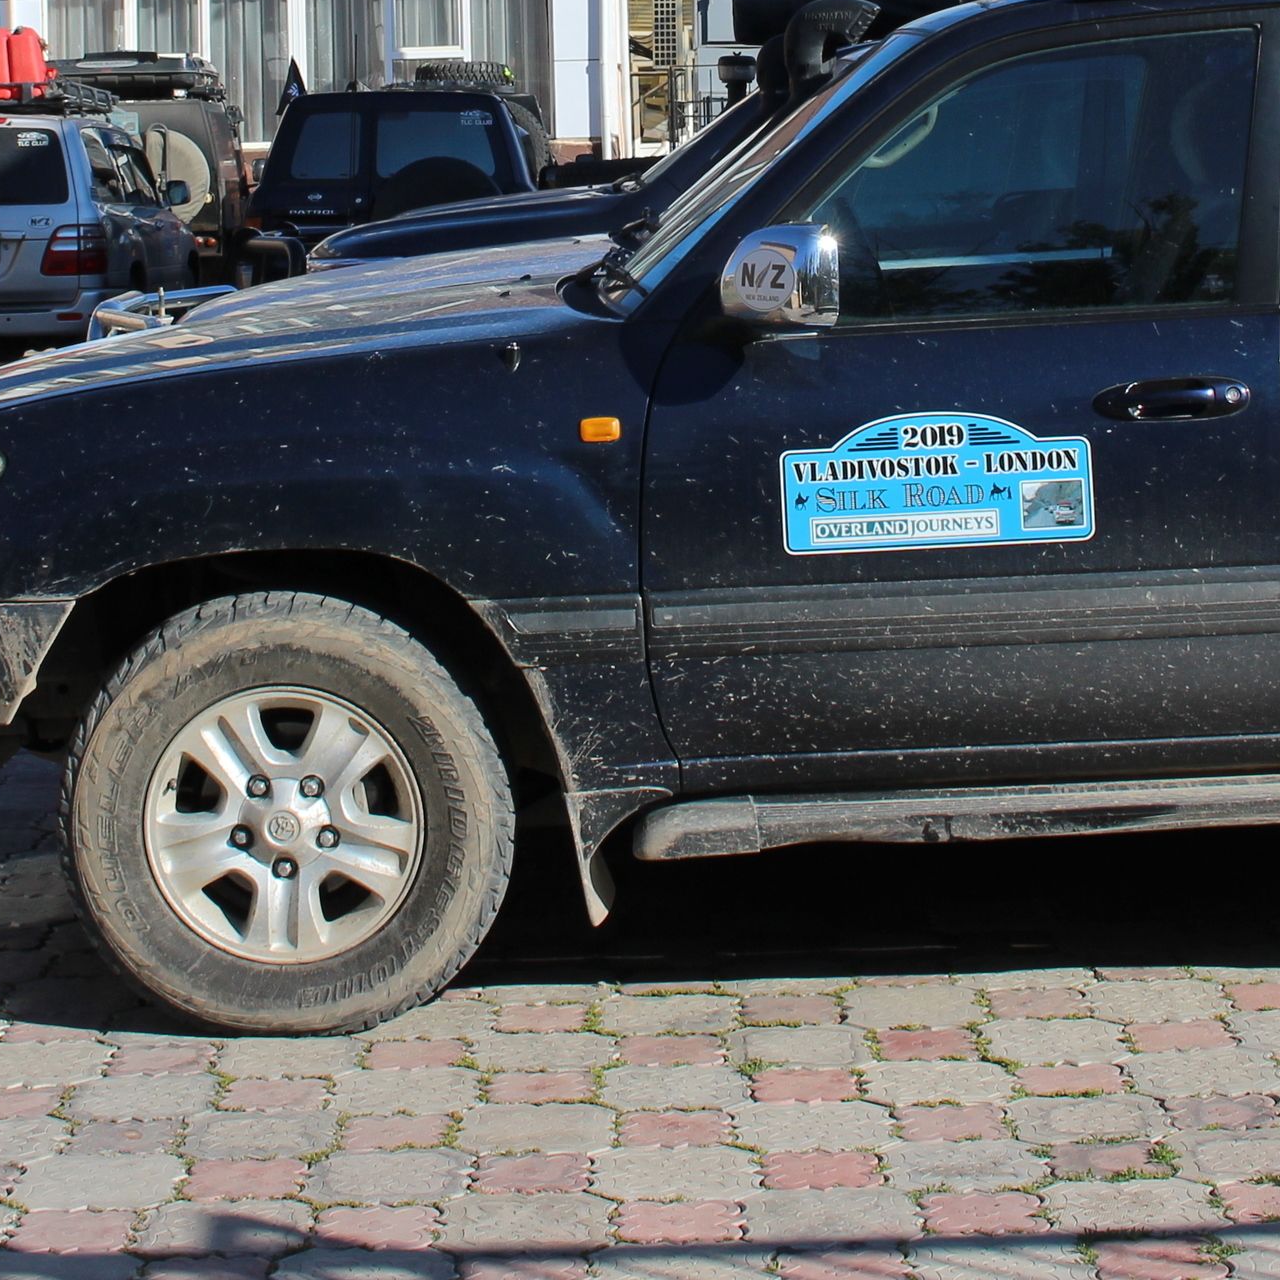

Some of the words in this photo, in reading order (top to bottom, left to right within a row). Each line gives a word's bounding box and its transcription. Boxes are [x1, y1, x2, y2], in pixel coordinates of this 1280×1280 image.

[902, 424, 964, 448] 2019
[793, 454, 958, 483] VLADIVOSTOK
[984, 449, 1078, 473] LONDON
[297, 714, 468, 1010] BRIDGESTONE
